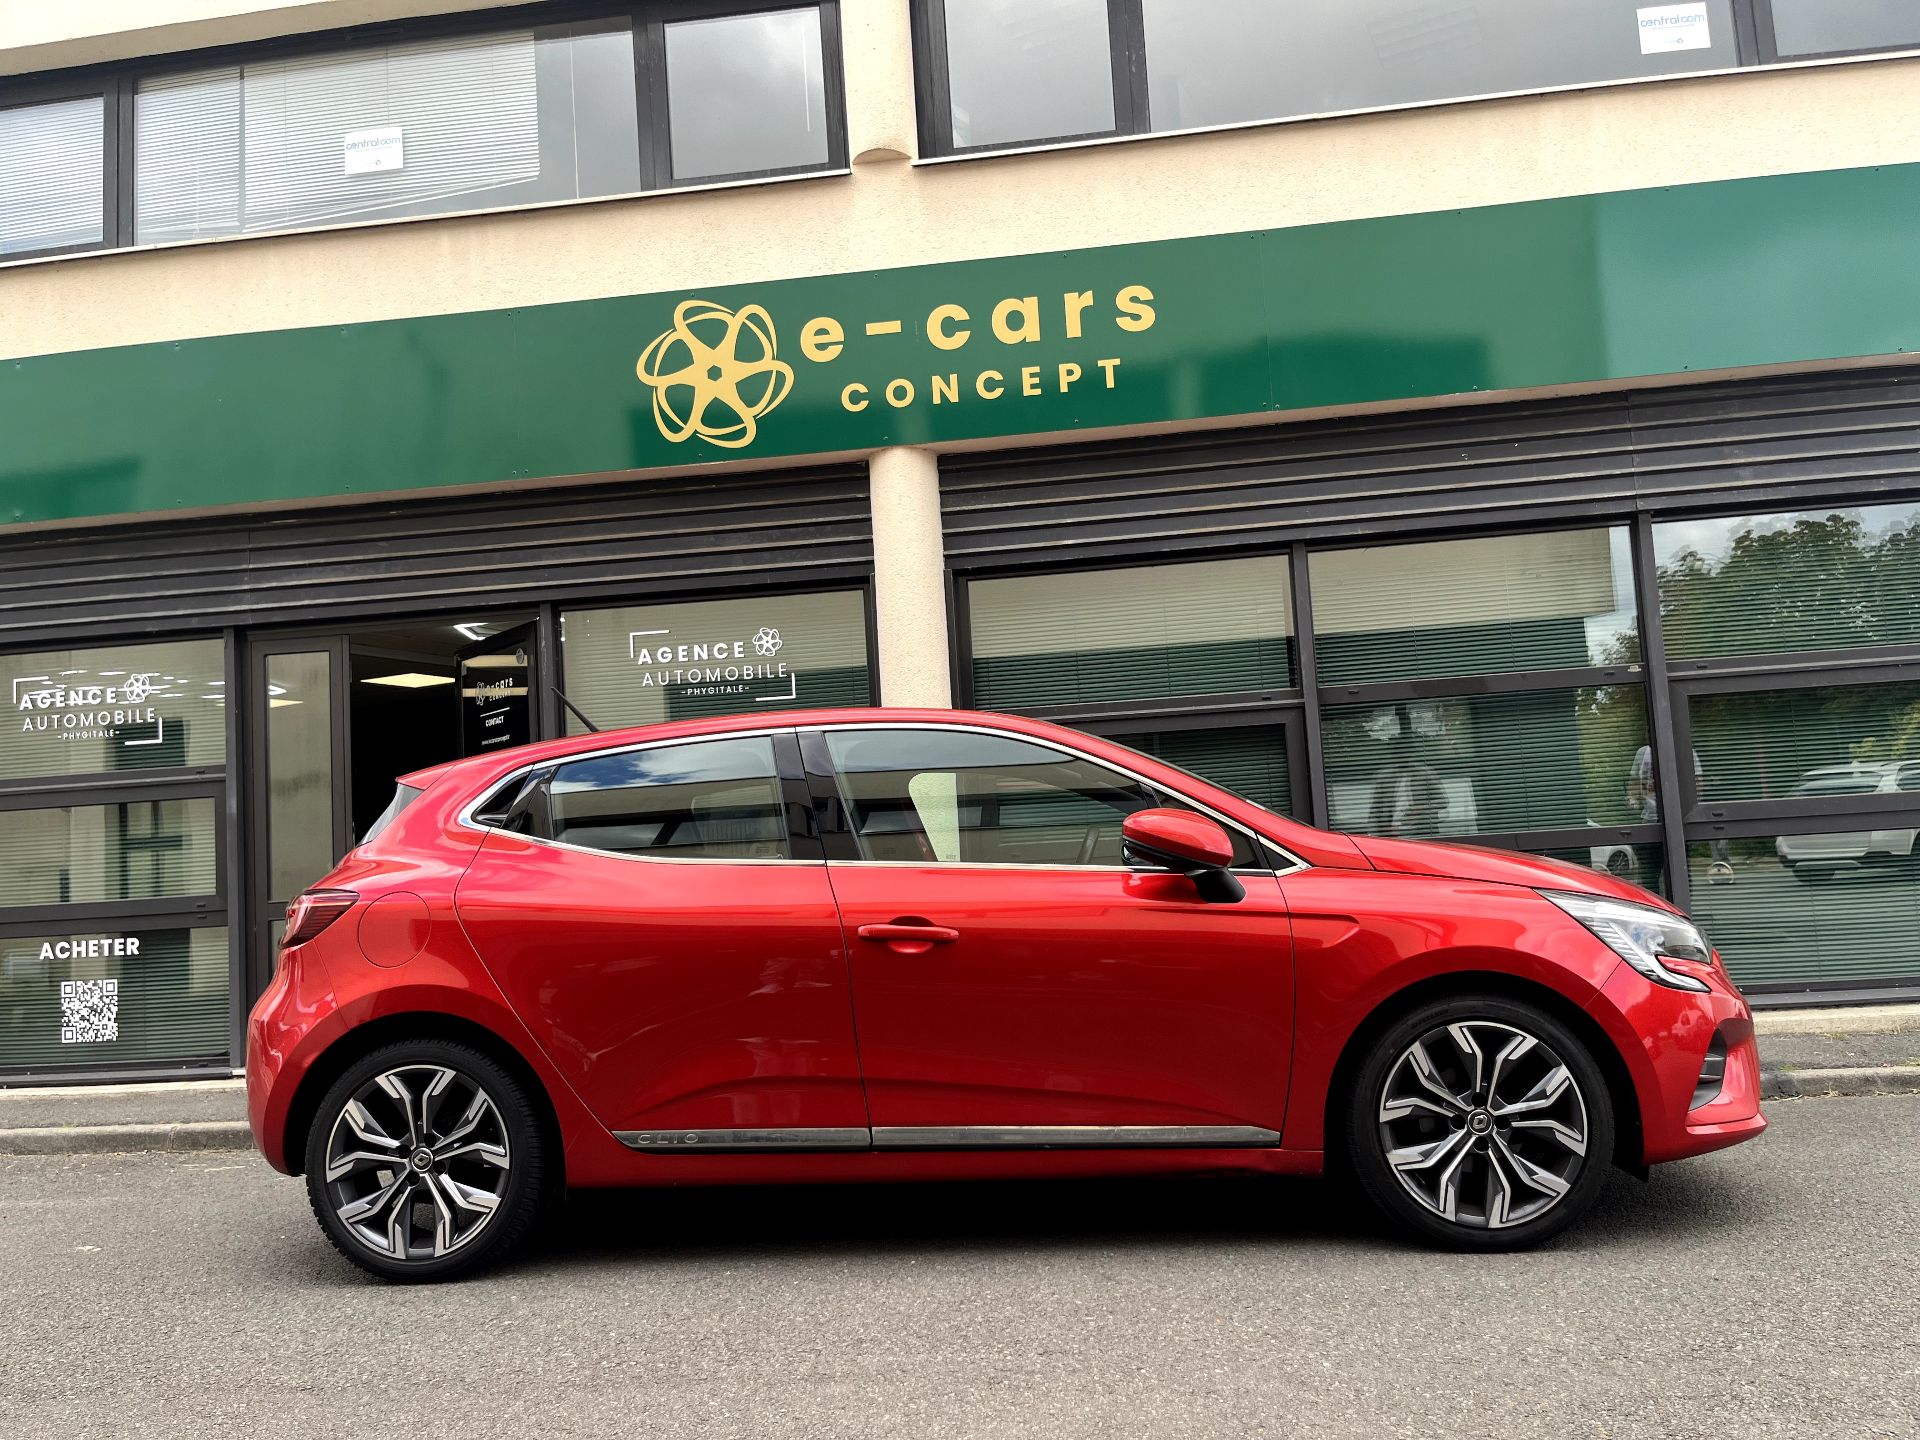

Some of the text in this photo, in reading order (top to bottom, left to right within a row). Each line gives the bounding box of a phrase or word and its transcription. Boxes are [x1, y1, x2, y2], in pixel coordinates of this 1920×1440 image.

[841, 358, 1121, 412] CONCEPT
[637, 641, 745, 665] AGENCE
[642, 663, 788, 687] AUTOMOBILE
[19, 687, 117, 711] AGENCE
[22, 708, 156, 732] AUTOMOBILE
[485, 715, 505, 727] CONTACT
[39, 937, 140, 960] ACHETER
[638, 1133, 699, 1144] CLIO
